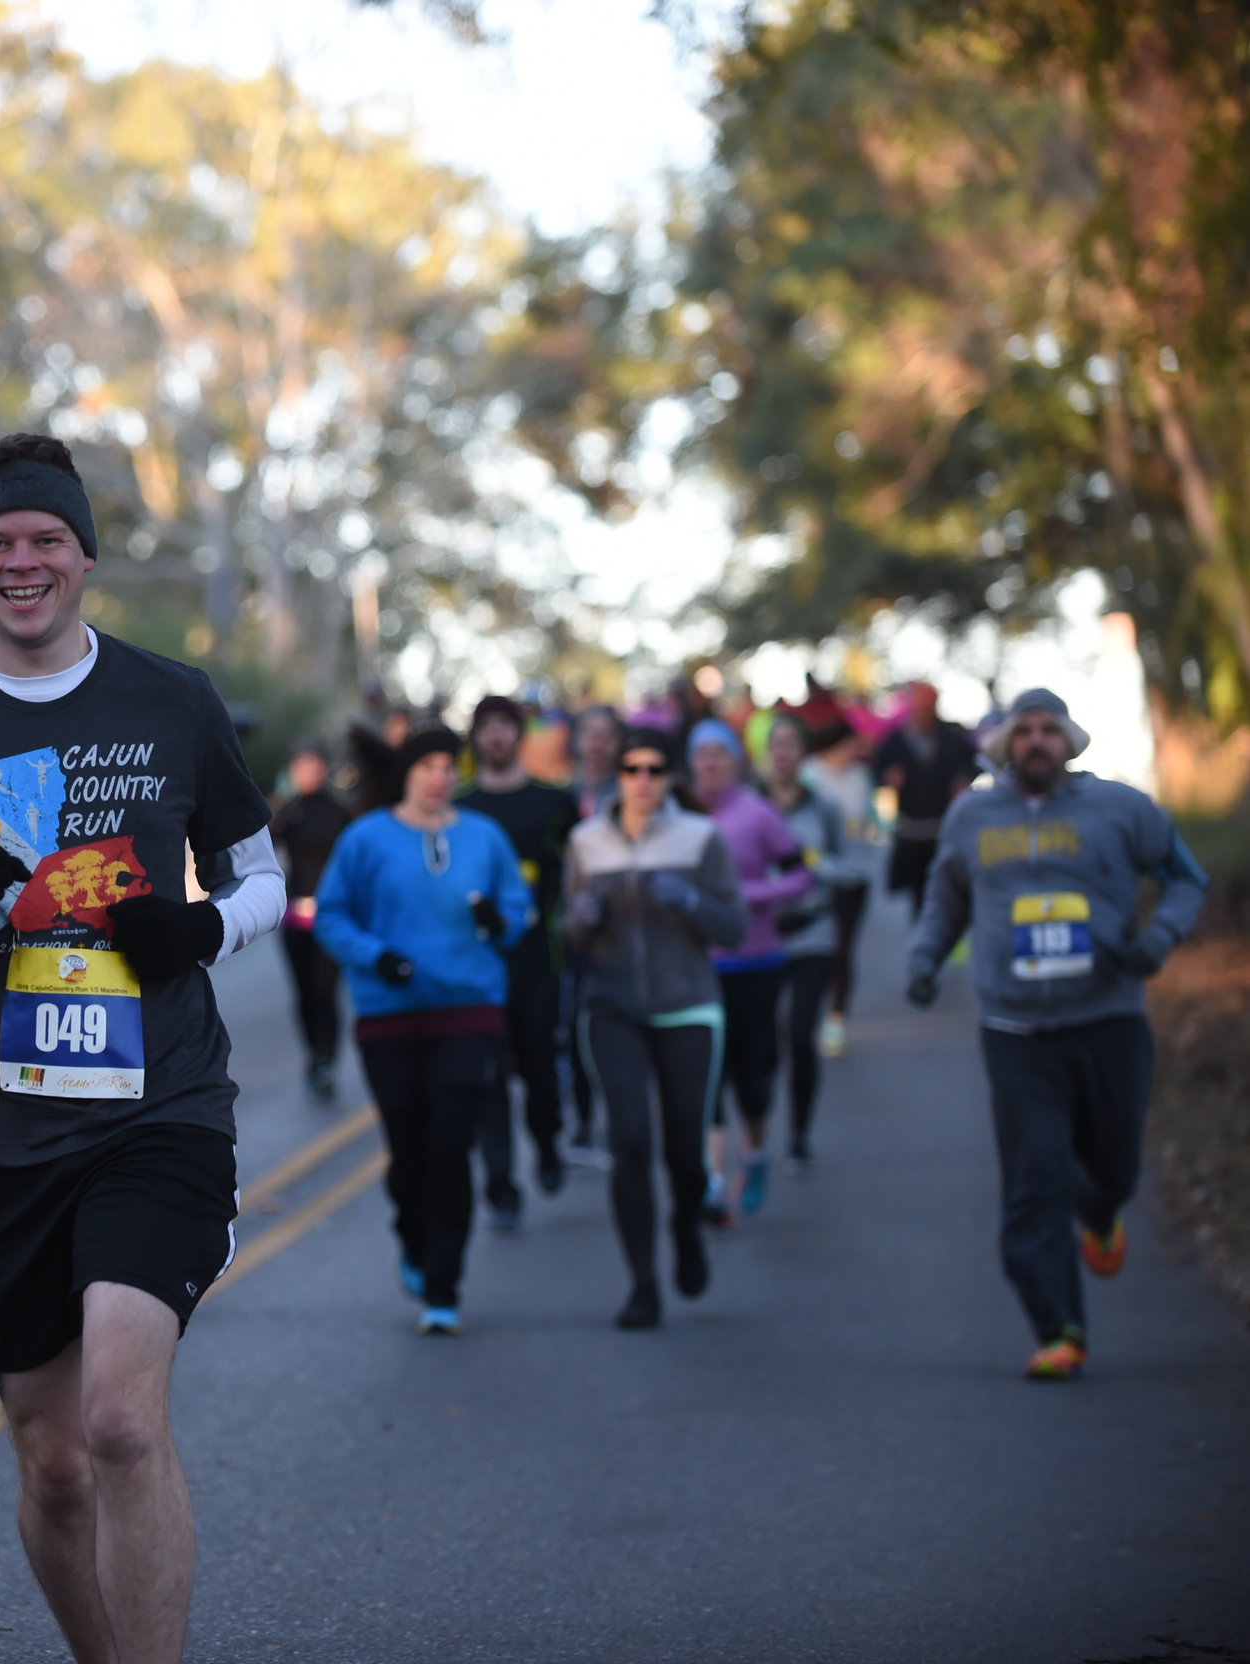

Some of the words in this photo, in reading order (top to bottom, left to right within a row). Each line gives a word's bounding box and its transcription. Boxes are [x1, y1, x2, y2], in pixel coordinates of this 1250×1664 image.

[62, 743, 154, 770] CAJUN
[69, 774, 166, 804] COUNTRY
[63, 808, 125, 837] RUN
[35, 1003, 107, 1054] 049
